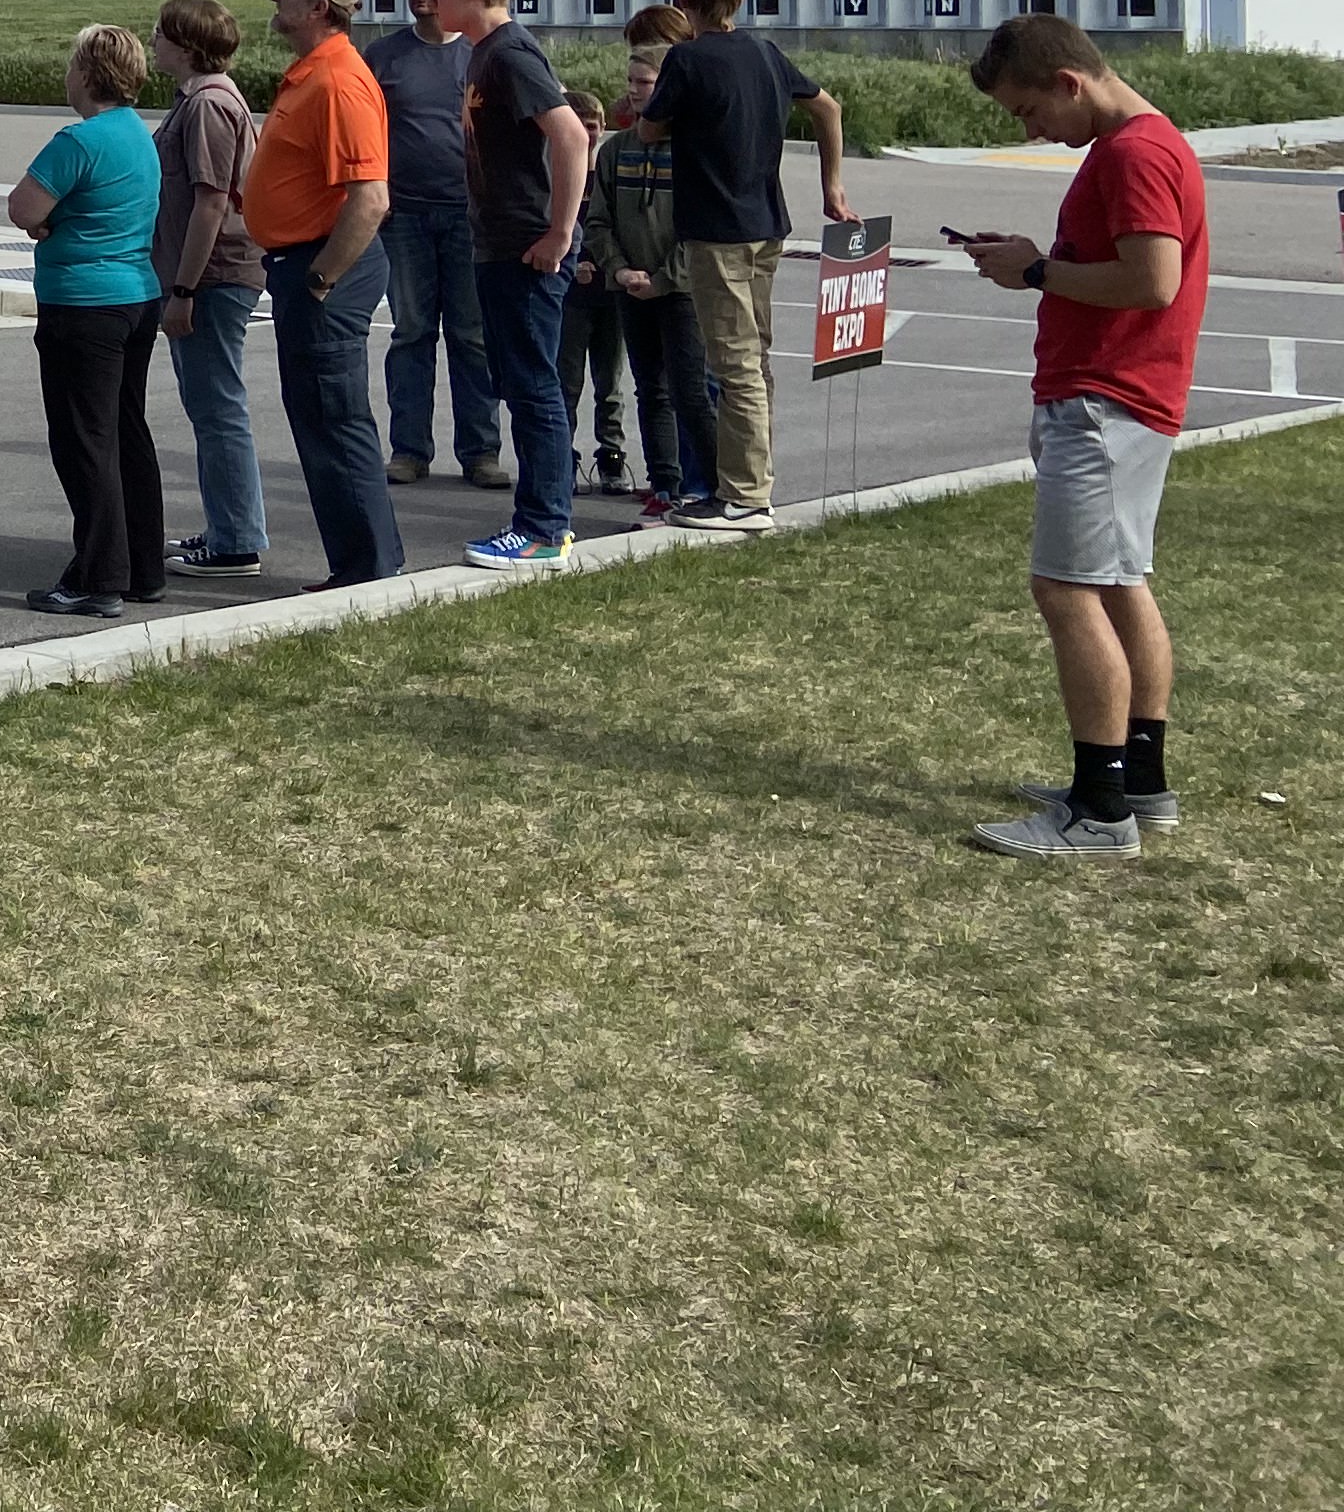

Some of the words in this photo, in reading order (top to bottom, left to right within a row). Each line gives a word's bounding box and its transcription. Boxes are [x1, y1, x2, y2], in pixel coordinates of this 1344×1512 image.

[821, 275, 850, 315] TINY
[850, 269, 885, 309] HOME
[833, 312, 865, 352] EXPO
